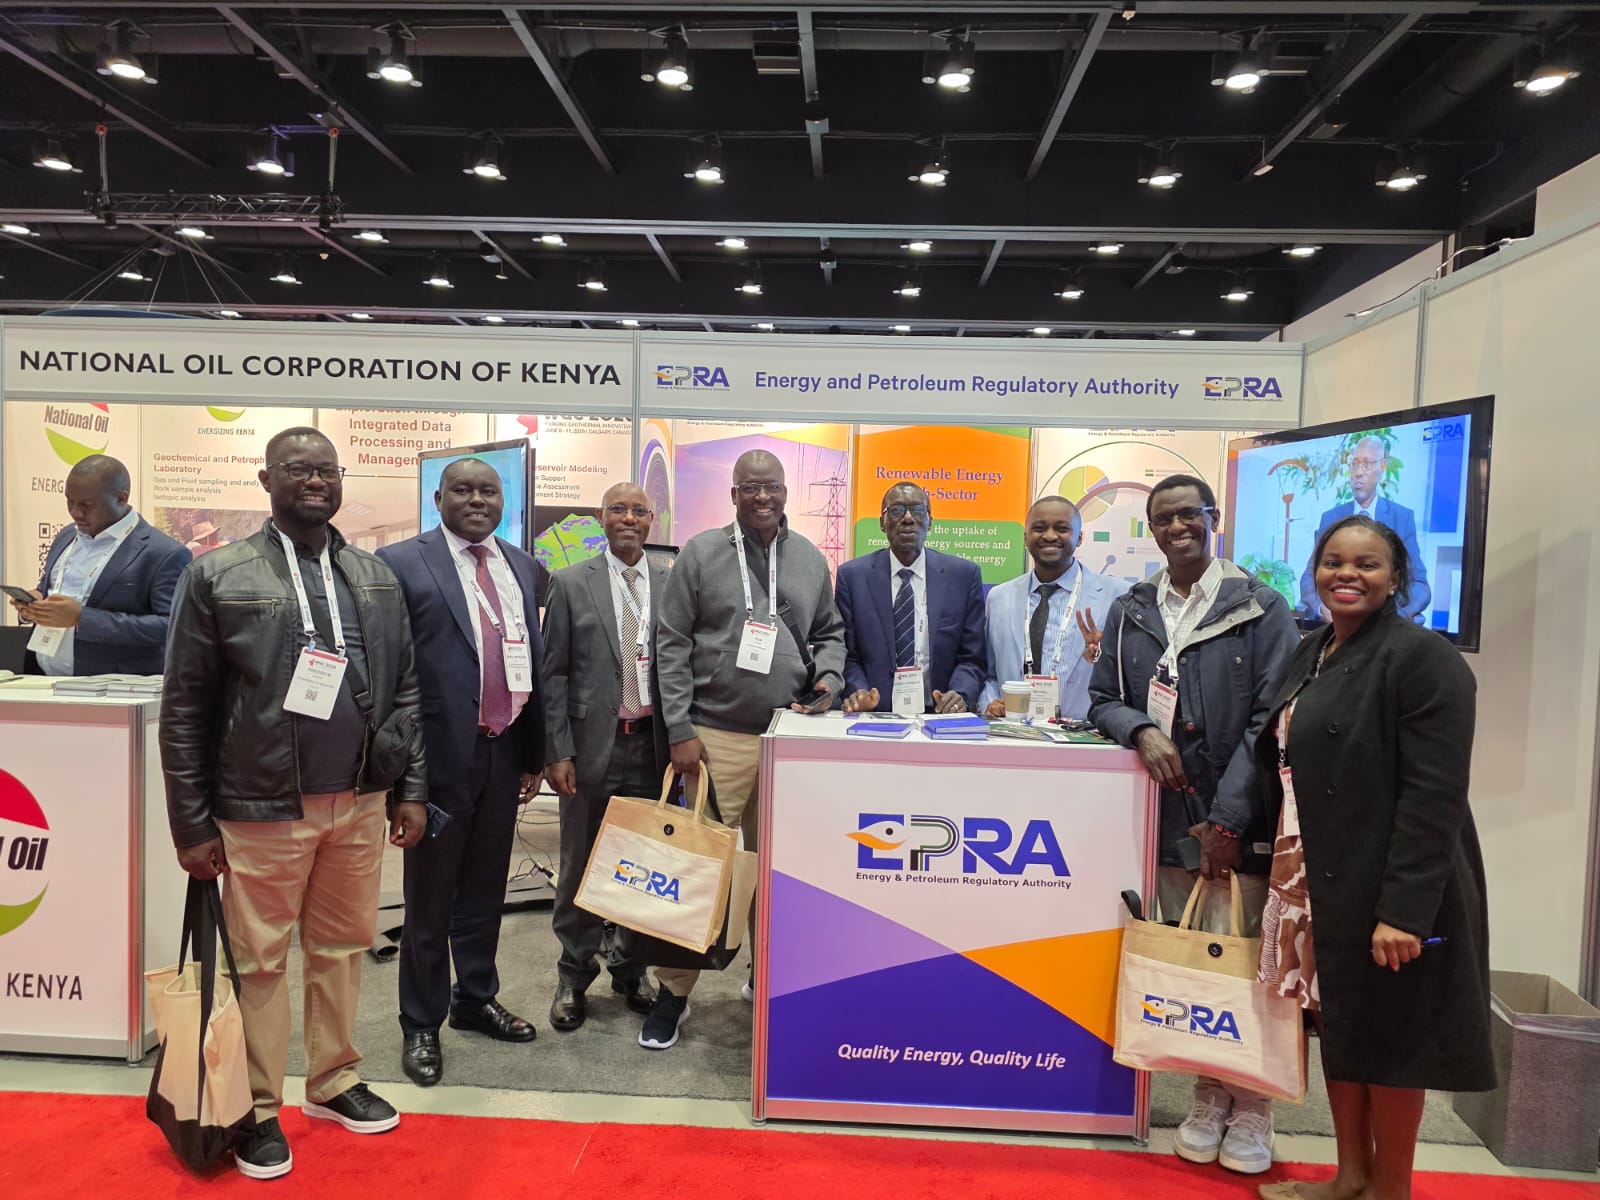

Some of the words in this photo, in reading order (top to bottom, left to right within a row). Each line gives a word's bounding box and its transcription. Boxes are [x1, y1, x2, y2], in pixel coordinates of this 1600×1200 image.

[20, 350, 174, 374] NATIONAL
[183, 354, 233, 375] OIL
[242, 355, 461, 381] CORPORATION
[472, 361, 511, 382] OF
[521, 362, 621, 386] KENYA
[654, 365, 730, 387] EPRA
[755, 371, 822, 392] Energy
[827, 374, 861, 390] and
[867, 373, 966, 391] Petroleum
[972, 375, 1078, 397] Regulatory
[1084, 377, 1179, 399] Authority
[1201, 376, 1283, 398] EPRA
[44, 405, 94, 431] National
[94, 414, 109, 433] Oil
[349, 418, 418, 432] Integrated
[421, 420, 452, 432] Data
[198, 427, 235, 436] ENERGIZING
[236, 428, 255, 436] KENYA
[1423, 423, 1464, 442] EPRA
[350, 435, 423, 450] Processing
[427, 438, 452, 449] and
[153, 453, 211, 462] Geochemical
[212, 455, 229, 463] and
[231, 456, 265, 466] Petroph
[153, 464, 202, 475] Laboratory
[535, 464, 567, 472] eservoir
[569, 465, 608, 475] Modeling
[876, 466, 952, 480] Renewable
[956, 468, 1005, 486] Energy
[32, 477, 65, 493] ENERG
[198, 479, 228, 487] sampling
[243, 480, 260, 488] analy
[540, 475, 566, 483] Support
[196, 486, 221, 495] analysis
[555, 492, 580, 500] Strategy
[924, 487, 978, 501] b-Sector
[180, 495, 206, 503] analysis
[934, 525, 950, 534] the
[952, 525, 984, 537] uptake
[988, 526, 998, 535] of
[868, 538, 890, 546] rene
[924, 540, 951, 550] nergy
[953, 541, 989, 549] sources
[992, 540, 1010, 550] and
[973, 554, 1007, 566] energy
[846, 812, 1071, 877] EPRA
[7, 836, 49, 871] Oil
[614, 859, 680, 902] EPRA
[856, 872, 892, 883] Energy
[906, 874, 959, 884] Petroleum
[962, 876, 1019, 888] Regulatory
[1022, 878, 1072, 889] Authority
[7, 972, 82, 1000] KENYA
[1140, 994, 1242, 1040] EPRA
[838, 1043, 899, 1061] Quality
[903, 1046, 964, 1066] Energy,
[969, 1049, 1032, 1069] Quality
[1036, 1052, 1066, 1071] Life
